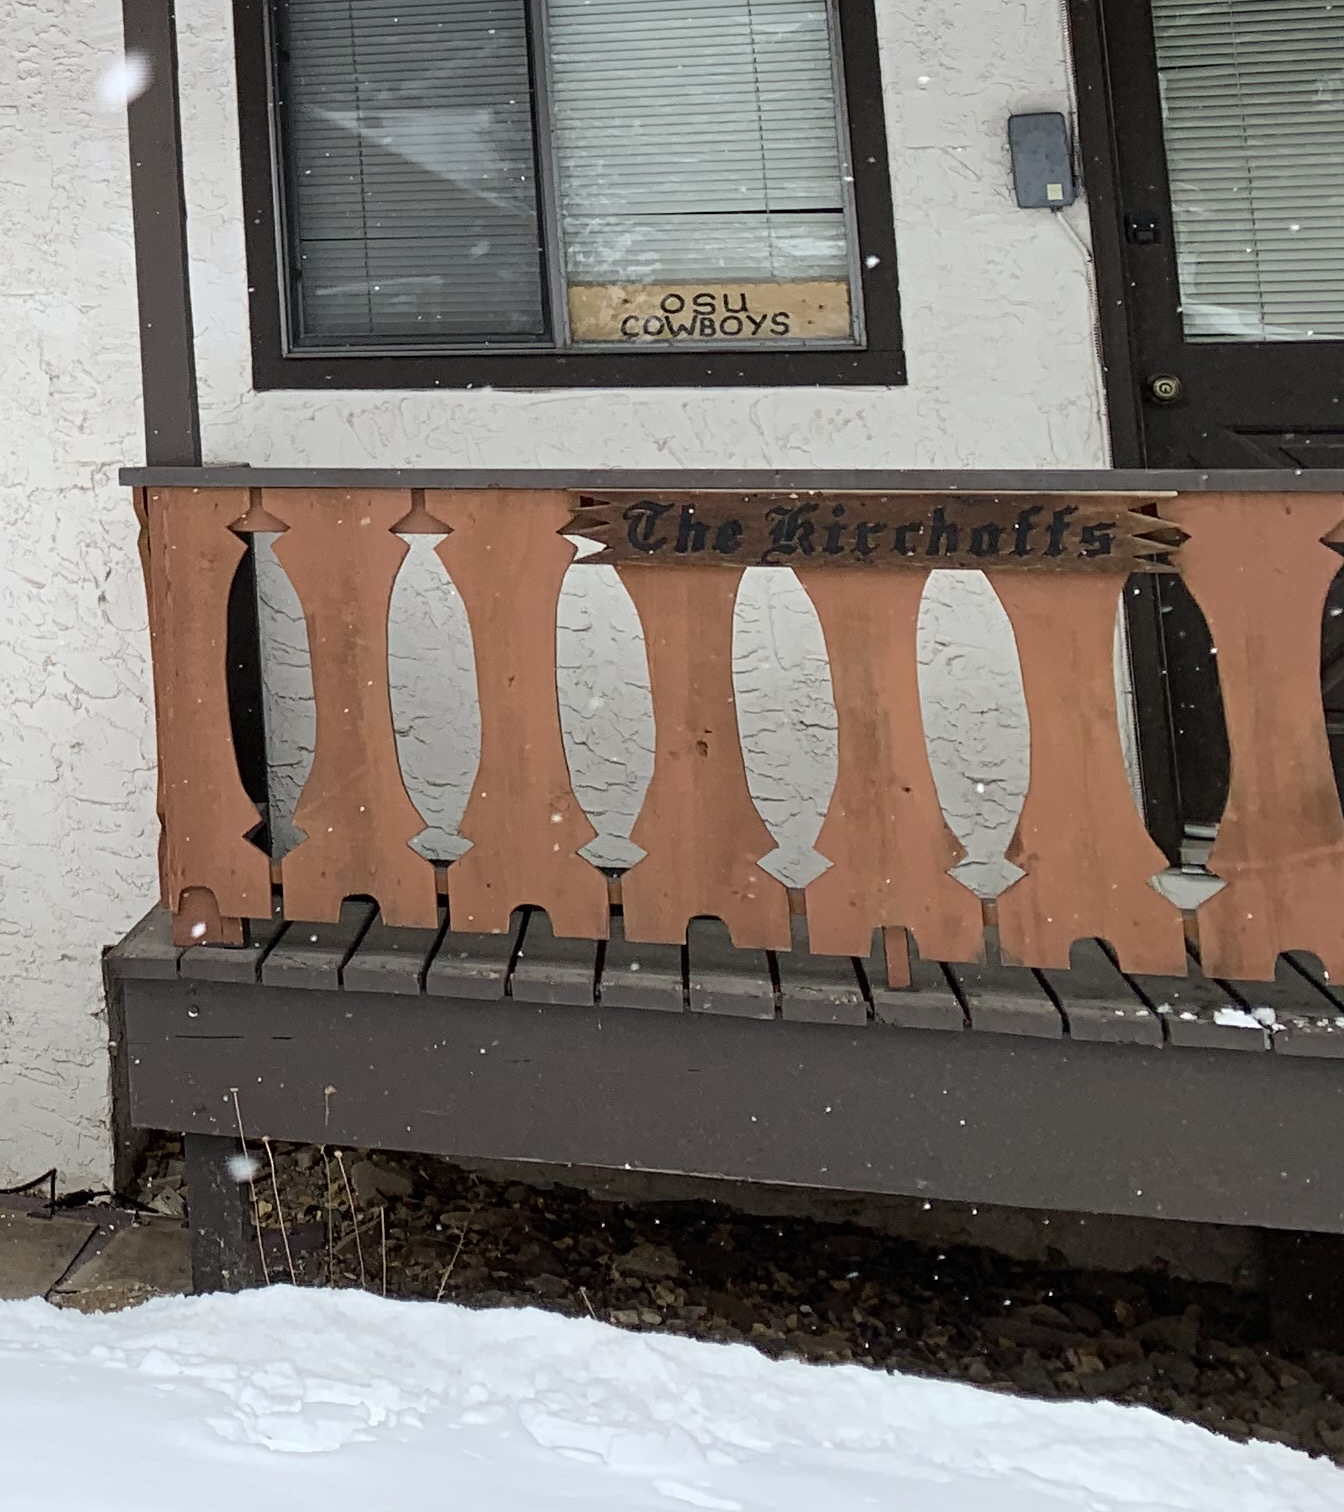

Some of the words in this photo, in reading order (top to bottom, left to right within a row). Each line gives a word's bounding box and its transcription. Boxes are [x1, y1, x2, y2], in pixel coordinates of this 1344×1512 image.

[660, 292, 748, 315] OSU
[620, 311, 790, 338] COWBOYS
[623, 499, 744, 554] The
